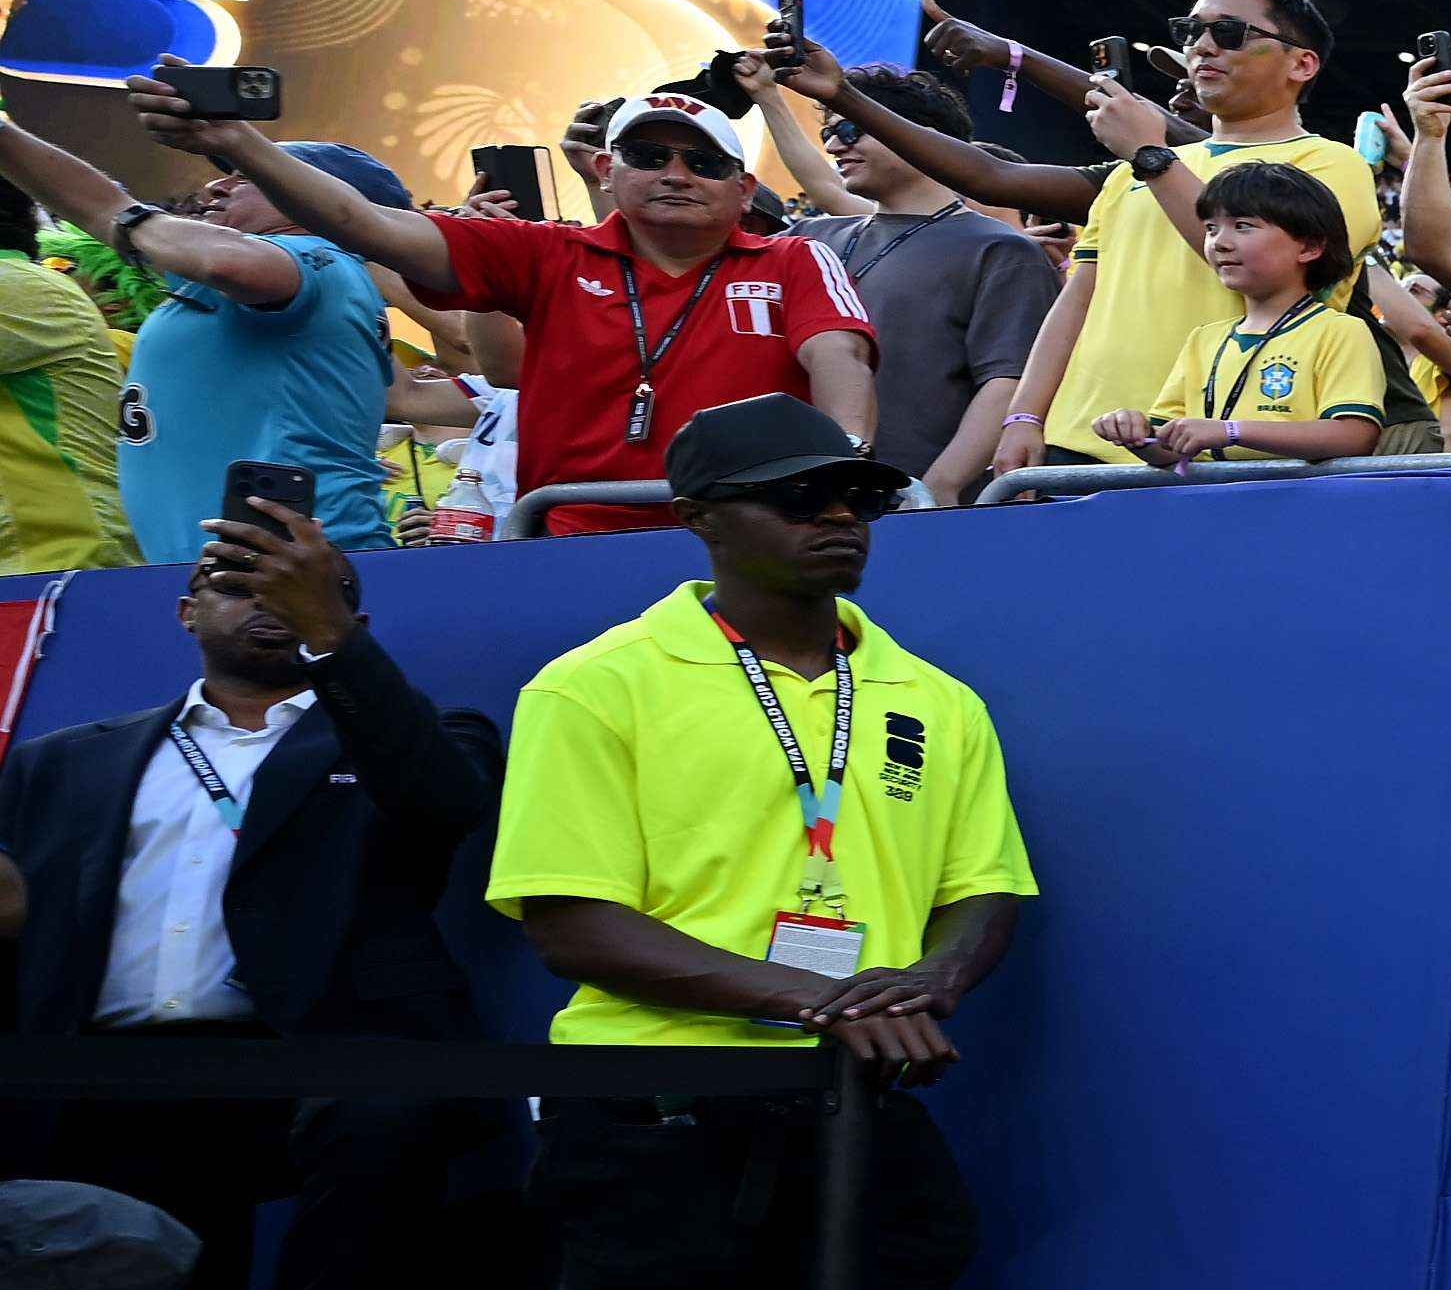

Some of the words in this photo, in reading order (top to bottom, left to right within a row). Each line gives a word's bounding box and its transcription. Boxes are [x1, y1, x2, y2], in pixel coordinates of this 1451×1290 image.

[732, 284, 778, 296] FPF
[755, 685, 778, 708] CUP
[767, 707, 797, 750] WORLD
[787, 748, 807, 772] FIFA
